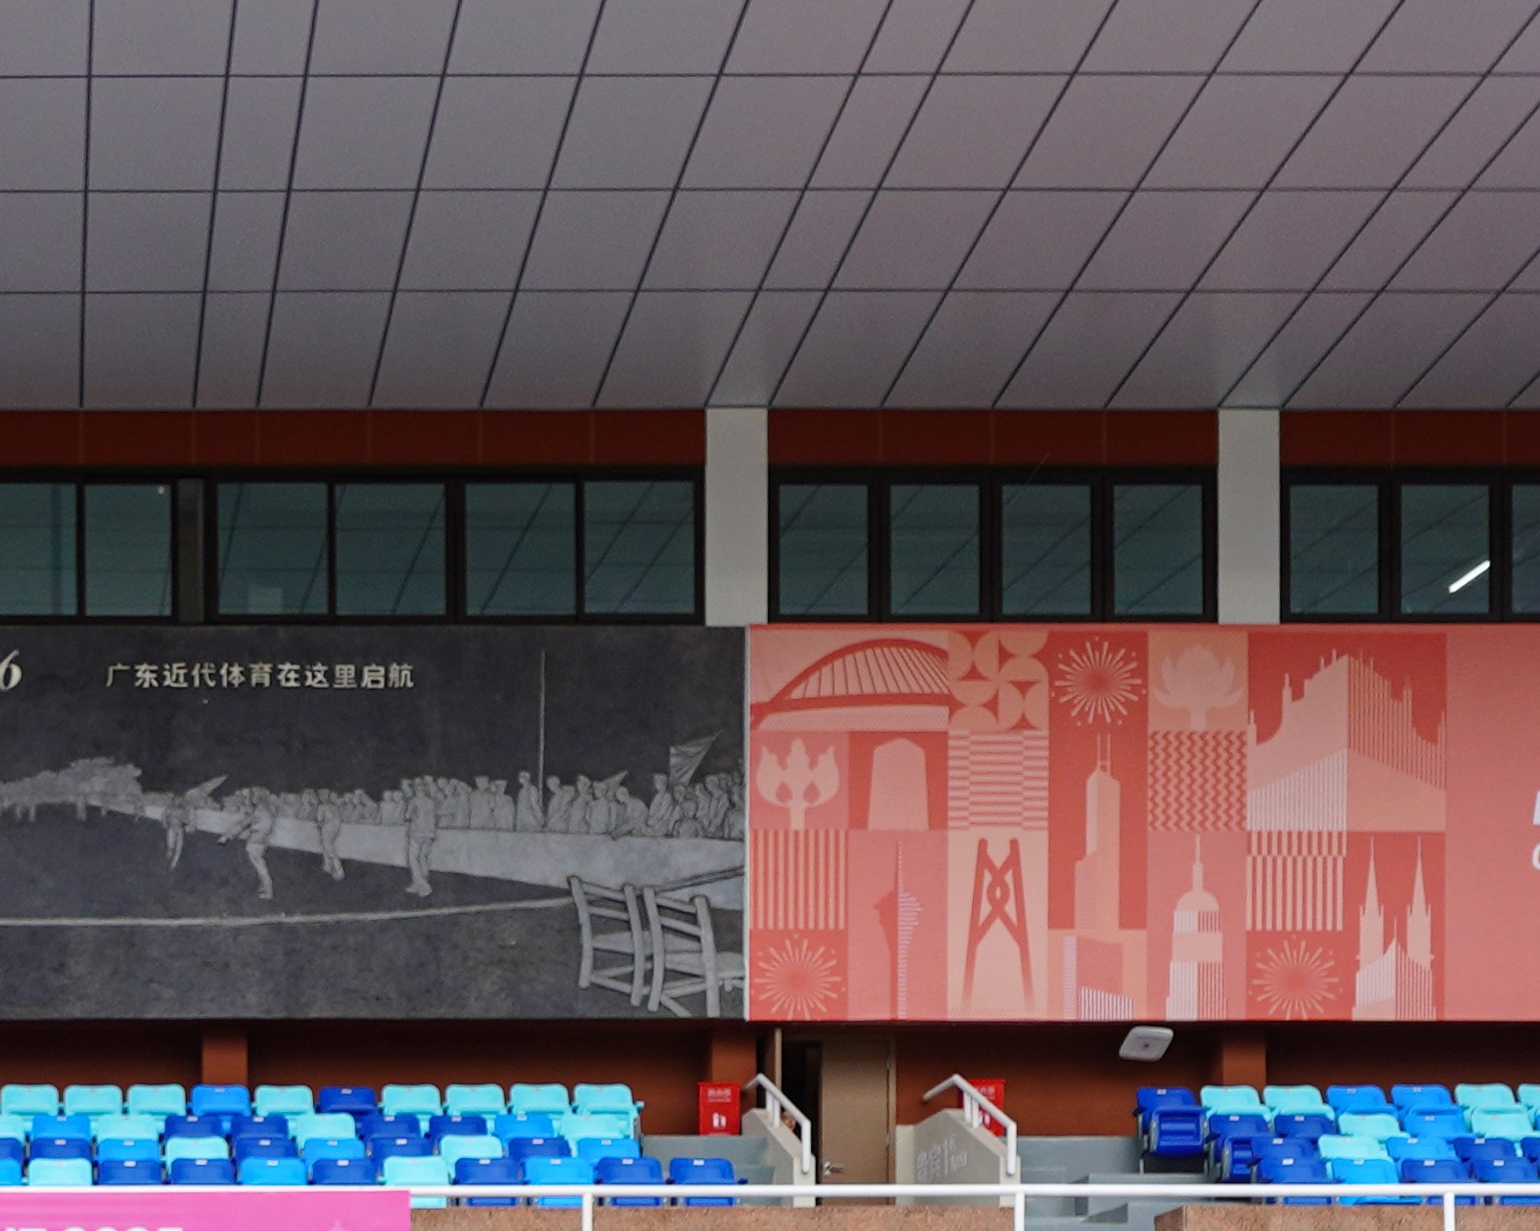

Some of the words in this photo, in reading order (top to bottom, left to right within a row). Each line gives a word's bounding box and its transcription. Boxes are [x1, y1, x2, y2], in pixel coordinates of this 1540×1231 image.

[106, 662, 414, 689] 广东近代体育在这里启航
